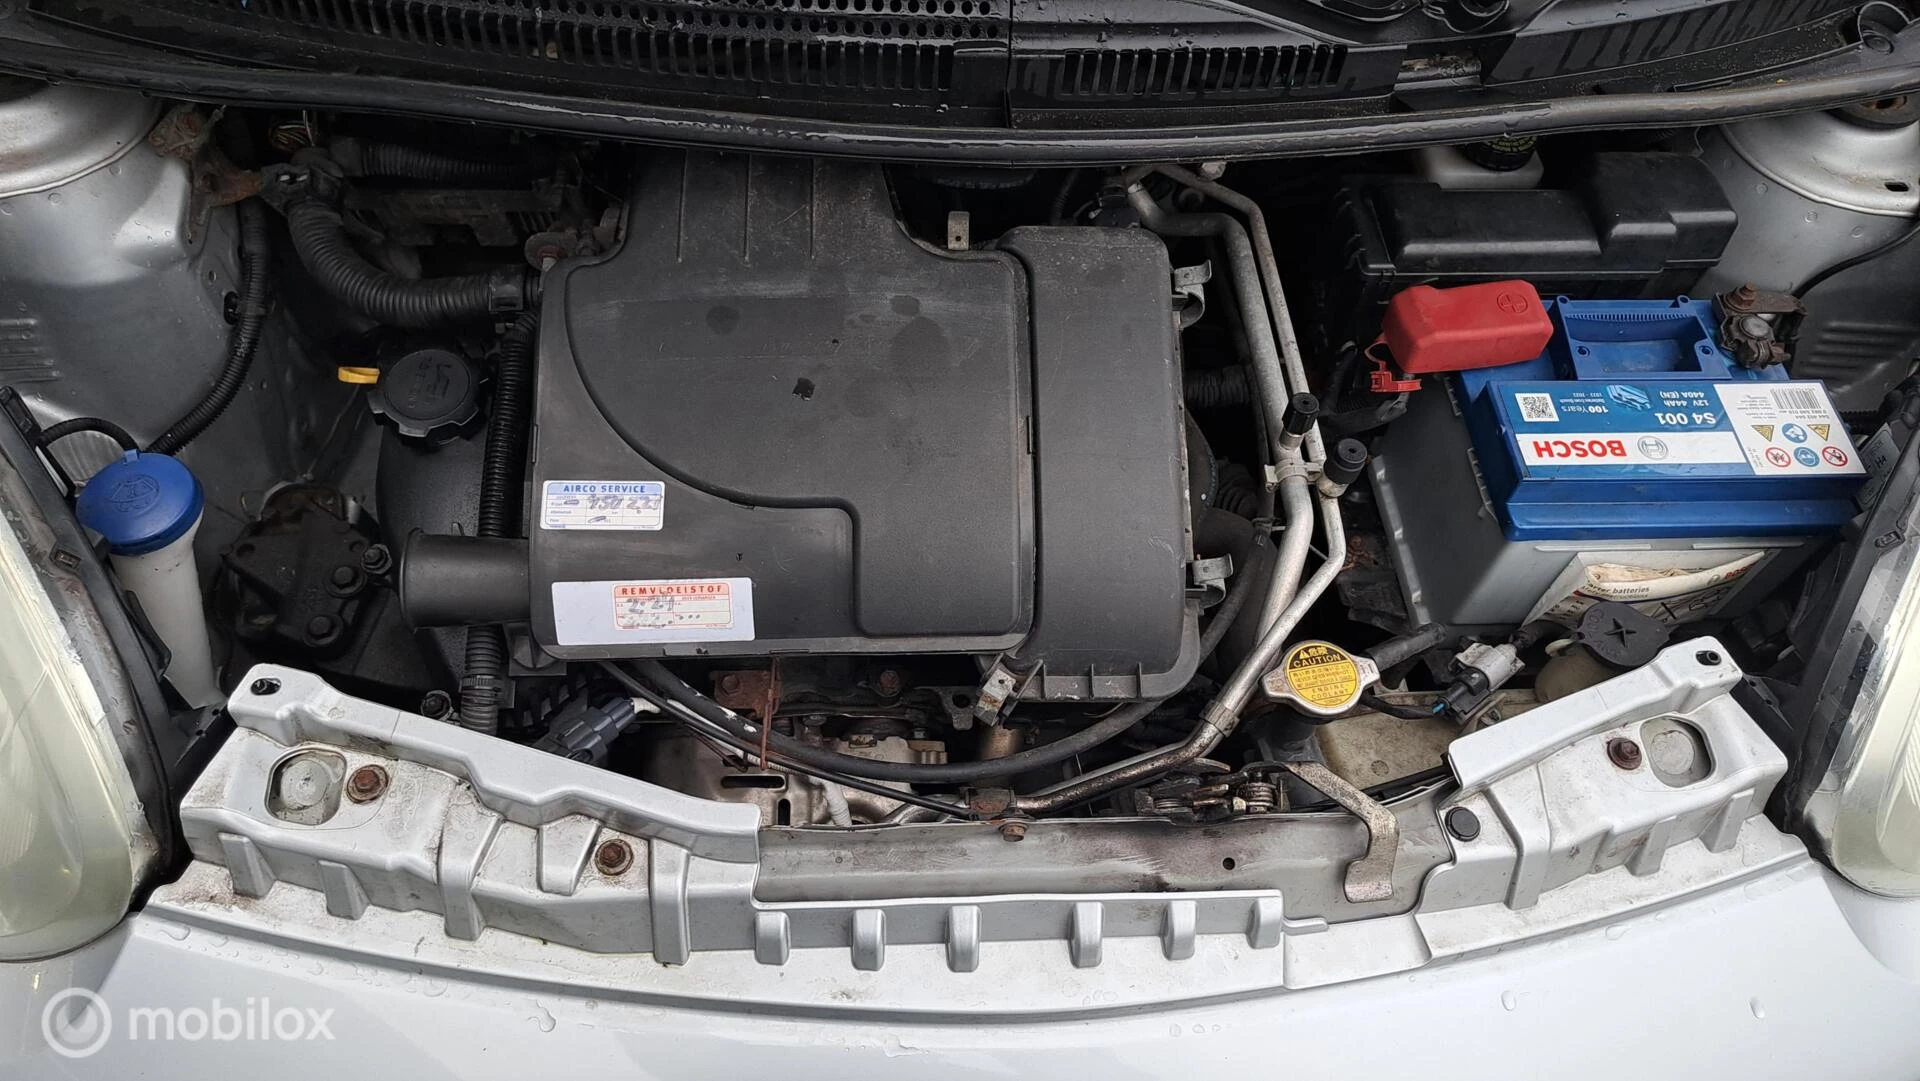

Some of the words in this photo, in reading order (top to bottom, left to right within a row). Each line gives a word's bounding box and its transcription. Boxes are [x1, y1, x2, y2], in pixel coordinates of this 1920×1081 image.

[1659, 390, 1680, 400] (EN)
[1681, 391, 1705, 399] 440A
[1663, 399, 1688, 407] 44Ah
[1692, 399, 1710, 407] 12V
[1560, 405, 1588, 414] Years
[1587, 405, 1609, 414] 100
[1654, 412, 1689, 426] 001
[1691, 412, 1717, 426] S4
[1532, 440, 1627, 458] BOSCH
[563, 484, 596, 493] AIRCO
[601, 484, 646, 494] SERVICE
[621, 585, 723, 596] REMVLOEISTOF
[1293, 653, 1342, 668] CAUTION
[1311, 689, 1350, 700] COOLANT
